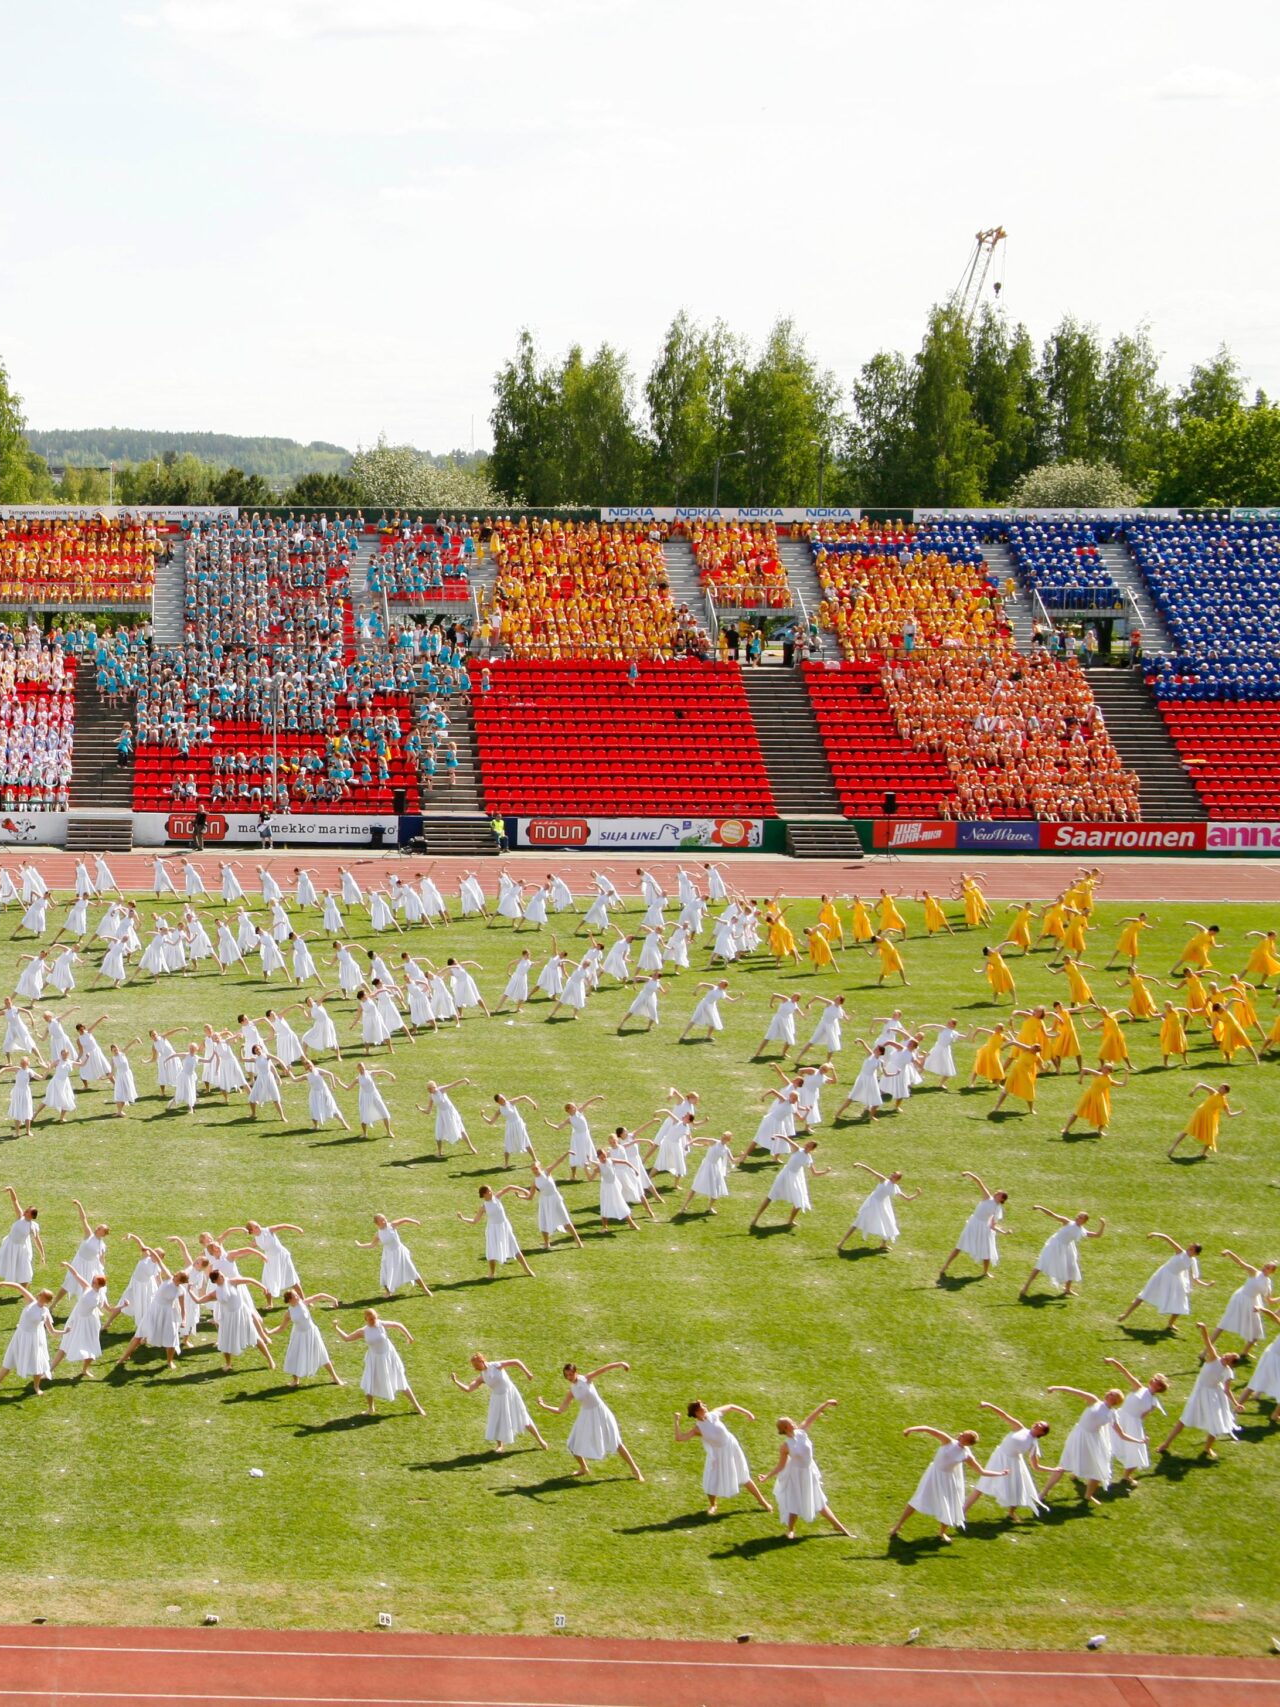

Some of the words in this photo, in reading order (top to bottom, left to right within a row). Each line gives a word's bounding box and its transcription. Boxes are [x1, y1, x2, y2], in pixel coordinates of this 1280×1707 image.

[608, 508, 654, 516] NOKIA
[675, 508, 721, 516] NOKIA
[738, 508, 784, 517] NOKIA
[805, 508, 852, 517] NOKIA
[238, 823, 312, 833] mamekko
[318, 824, 394, 834] marimeo
[895, 823, 922, 834] UUSI
[600, 831, 627, 842] SILJA
[631, 831, 657, 841] LINE
[1054, 826, 1195, 847] Saarioinen
[555, 1616, 565, 1625] 27
